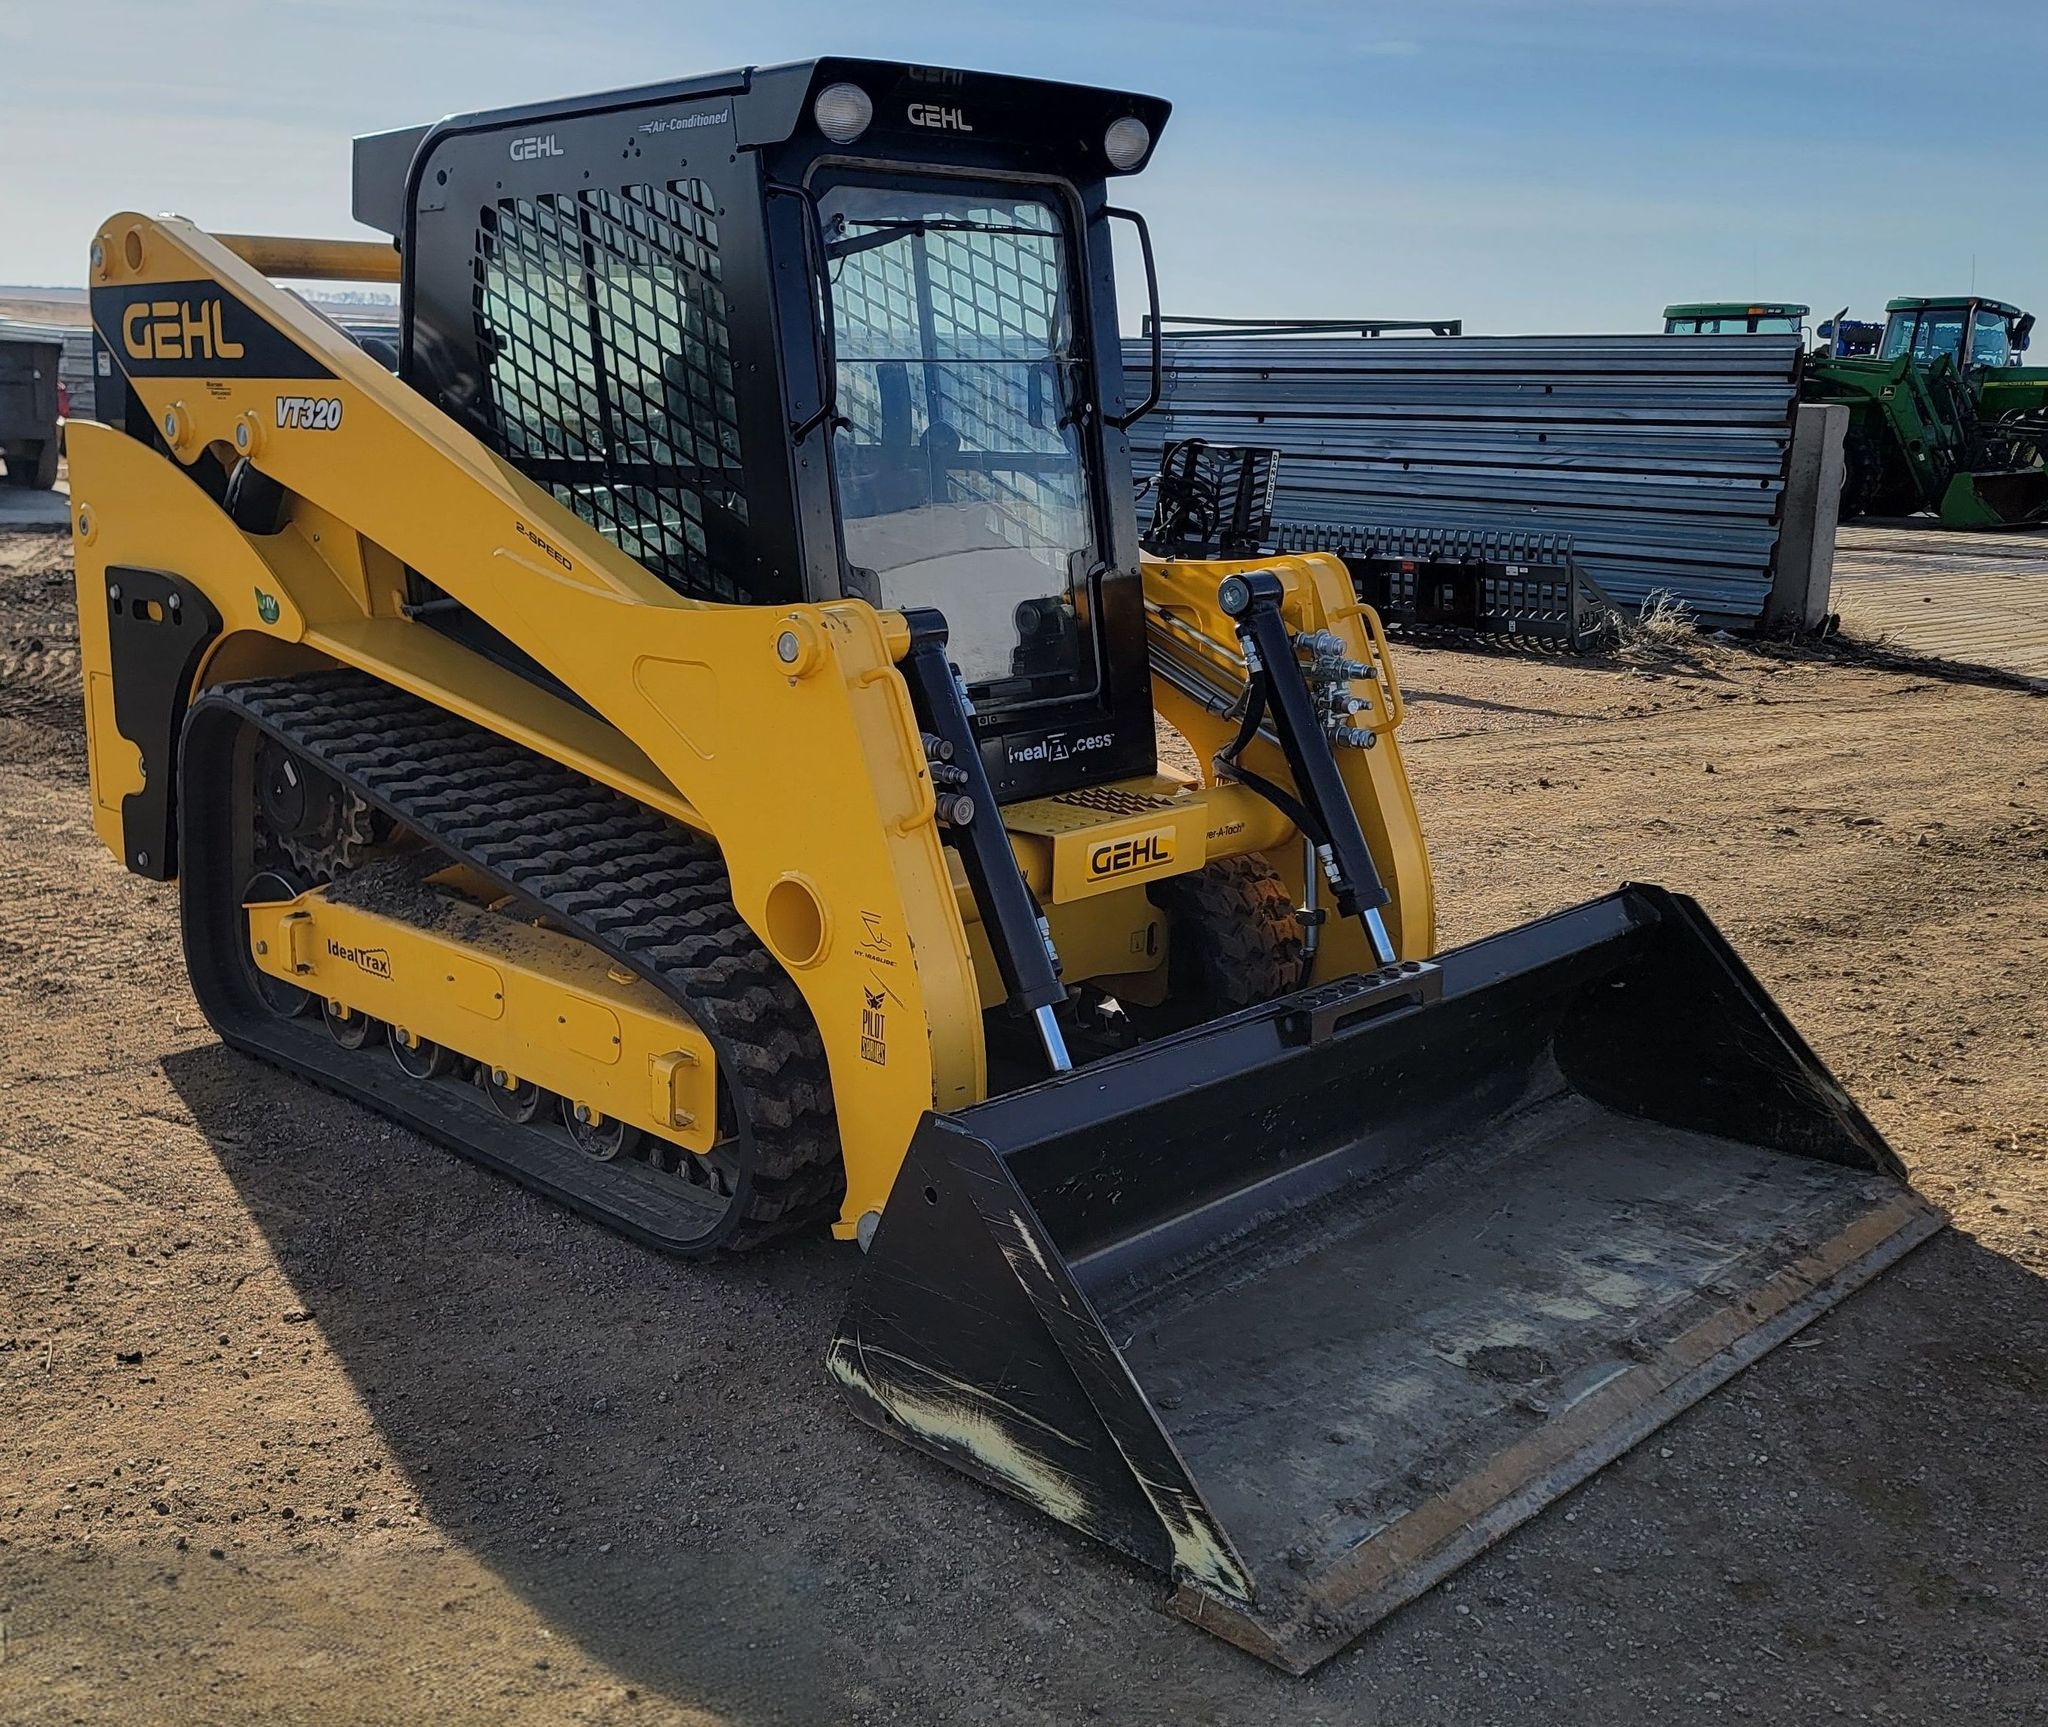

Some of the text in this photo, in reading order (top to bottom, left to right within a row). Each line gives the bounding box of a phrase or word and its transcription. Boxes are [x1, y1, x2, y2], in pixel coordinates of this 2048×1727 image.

[653, 109, 729, 134] Air-Conditioned
[907, 103, 973, 131] GEHL
[509, 134, 564, 161] GEHL
[122, 299, 244, 359] GEHL
[275, 396, 342, 430] VT320
[1266, 454, 1278, 506] DANUSER
[516, 521, 572, 571] 2-SPEED
[1091, 835, 1168, 875] GEHL
[327, 938, 388, 975] IdealTrax
[862, 1008, 886, 1041] PILOT
